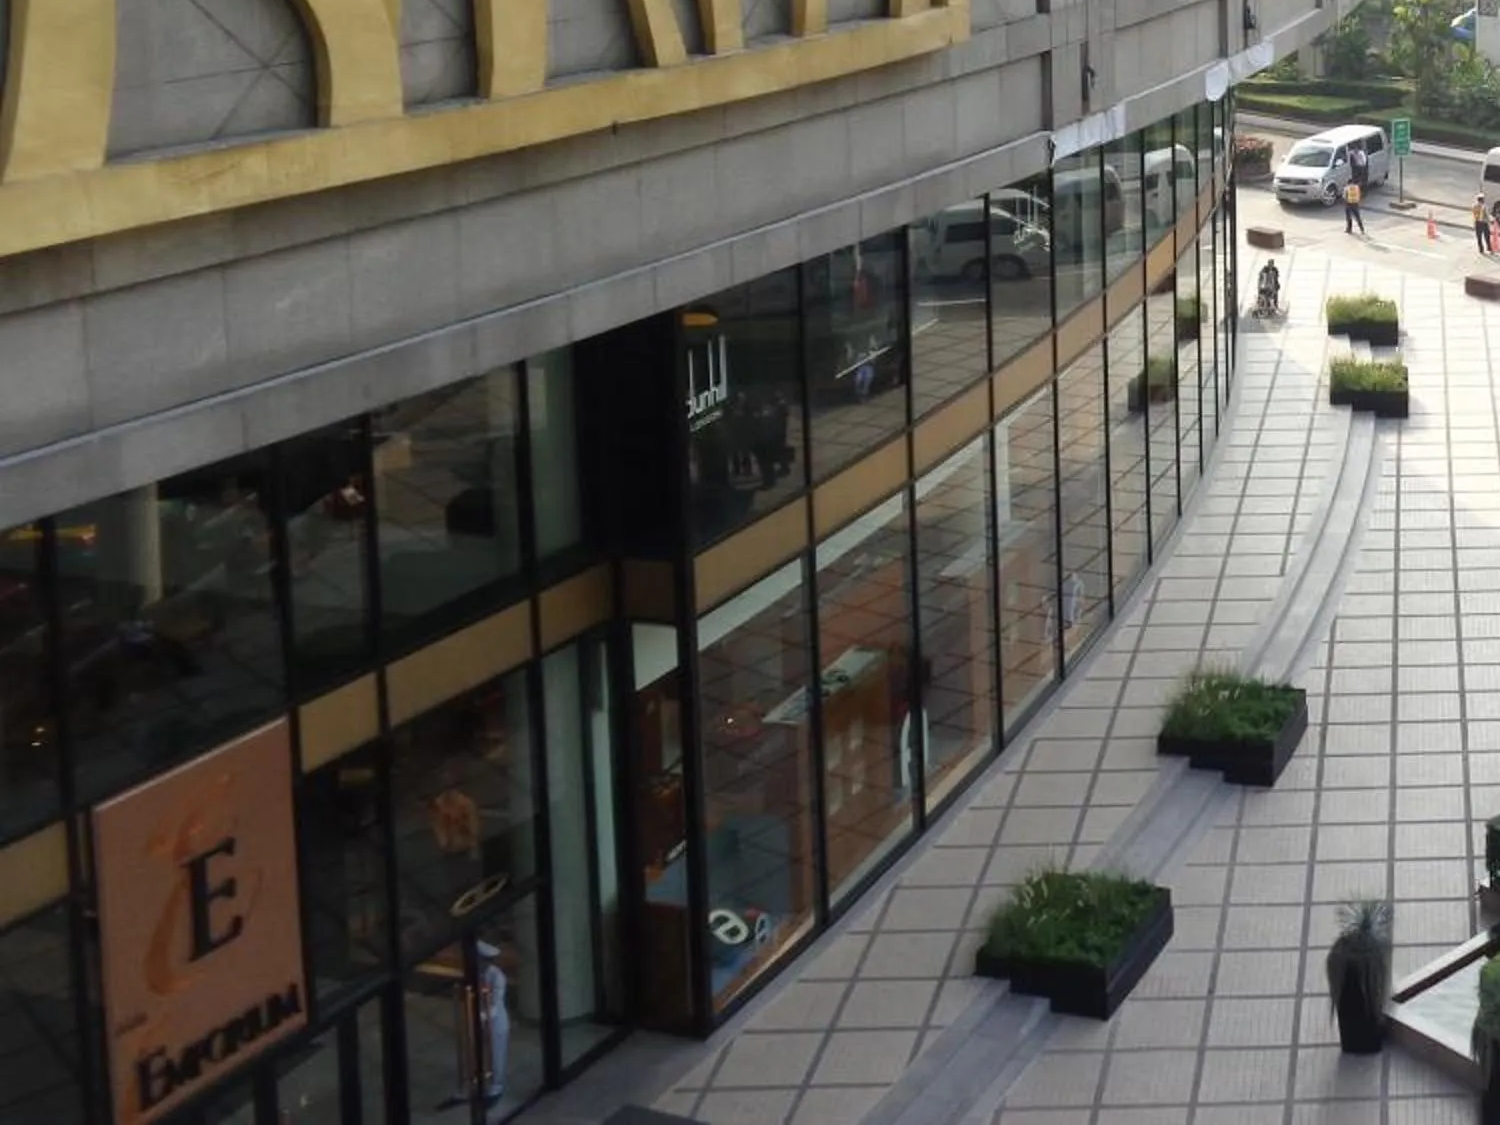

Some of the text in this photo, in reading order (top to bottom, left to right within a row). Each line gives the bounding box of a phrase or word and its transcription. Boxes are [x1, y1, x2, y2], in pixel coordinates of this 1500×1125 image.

[685, 334, 728, 419] dunhill
[179, 835, 244, 965] E
[134, 981, 303, 1114] EMPORIUM
